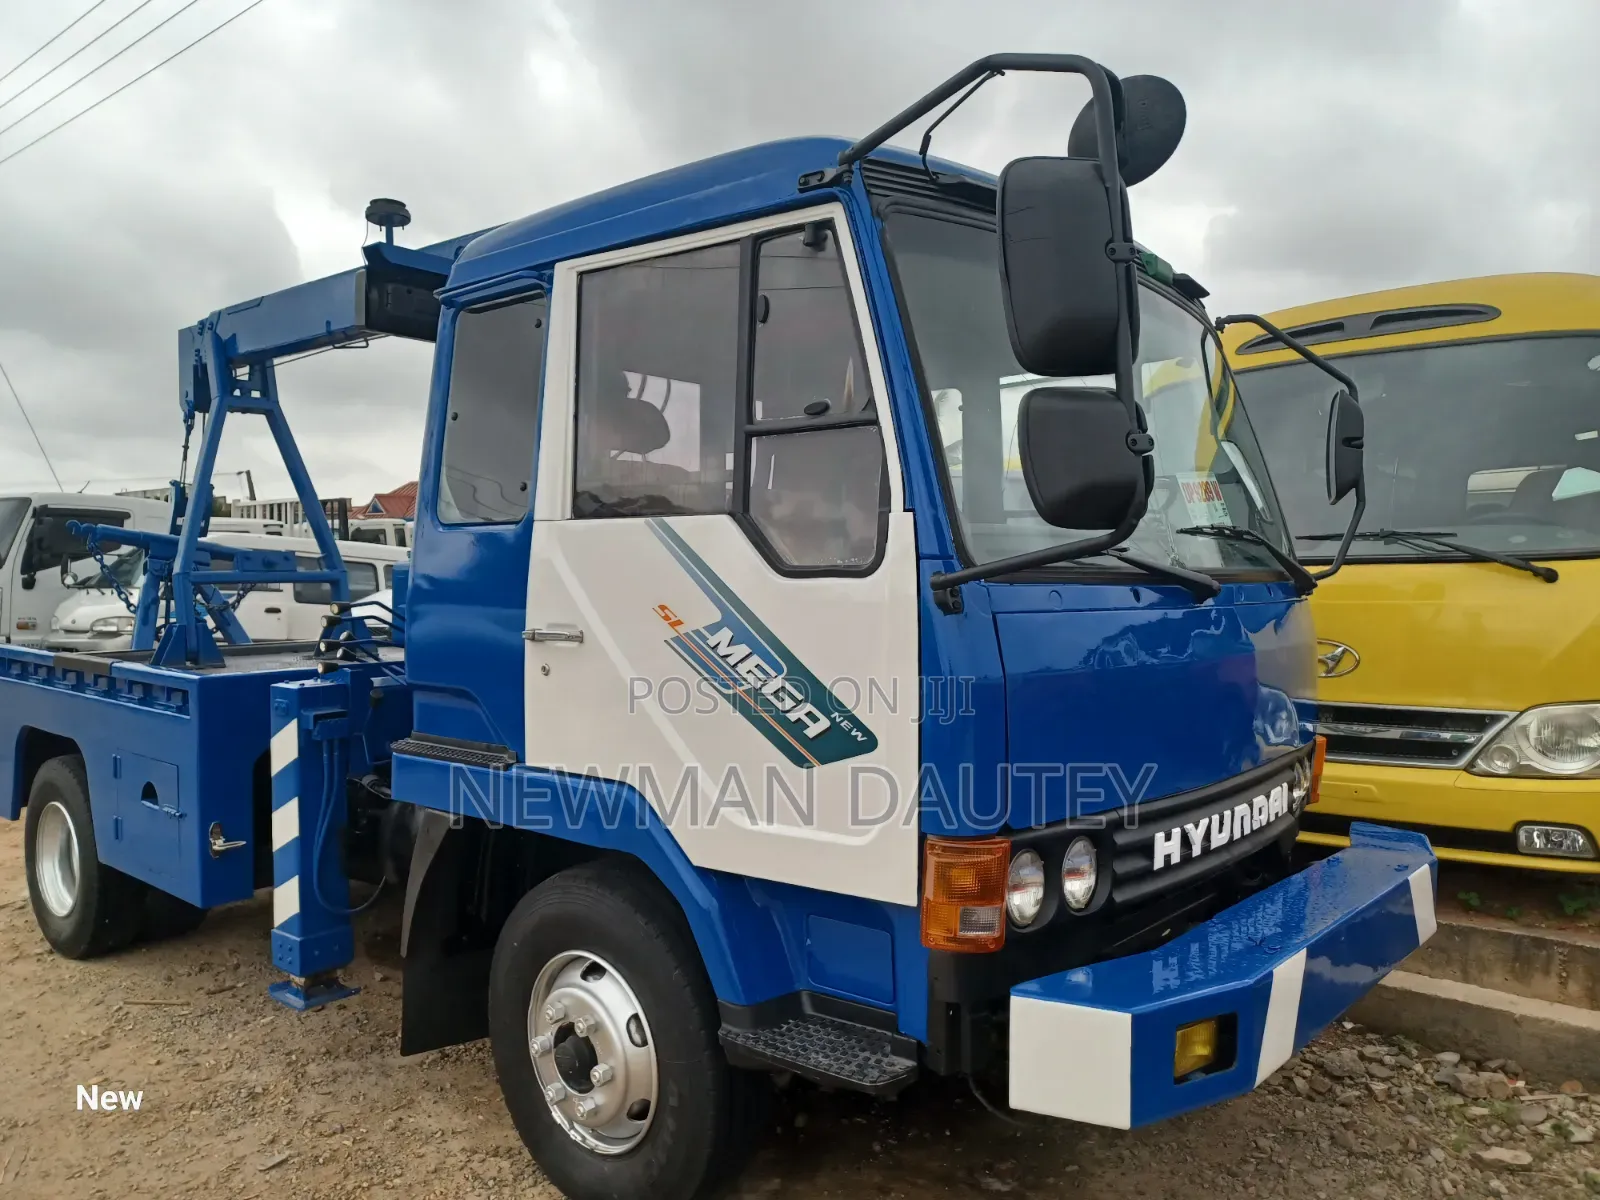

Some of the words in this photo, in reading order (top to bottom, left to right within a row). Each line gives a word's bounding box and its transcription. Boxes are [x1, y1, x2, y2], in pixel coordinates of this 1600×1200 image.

[652, 604, 685, 628] SL
[706, 626, 832, 740] MEGA
[830, 711, 868, 742] NEW
[1153, 782, 1289, 871] HYUNDAI
